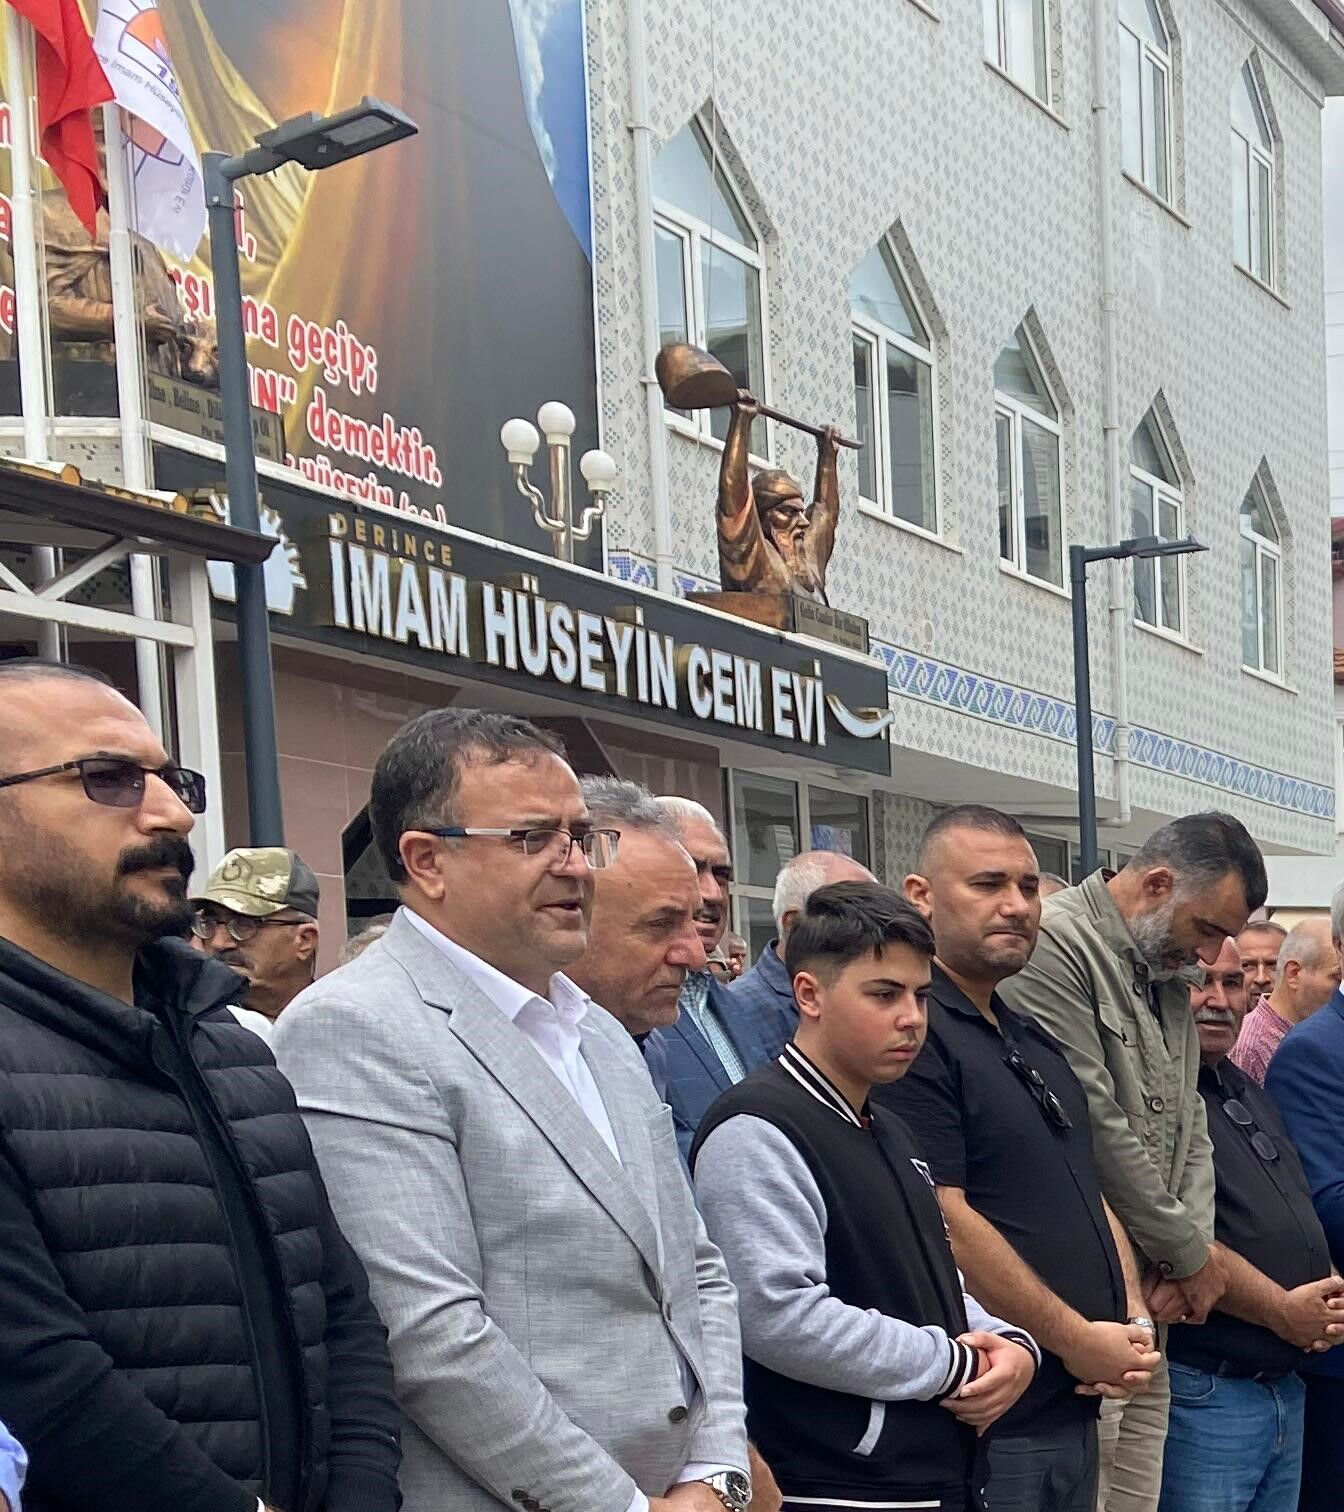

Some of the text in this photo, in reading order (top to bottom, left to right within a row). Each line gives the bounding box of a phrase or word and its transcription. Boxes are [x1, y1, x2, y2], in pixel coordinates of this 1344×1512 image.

[306, 386, 442, 488] demektir.
[329, 514, 827, 747] İMAM HÜSEYİN CEM EVİ
